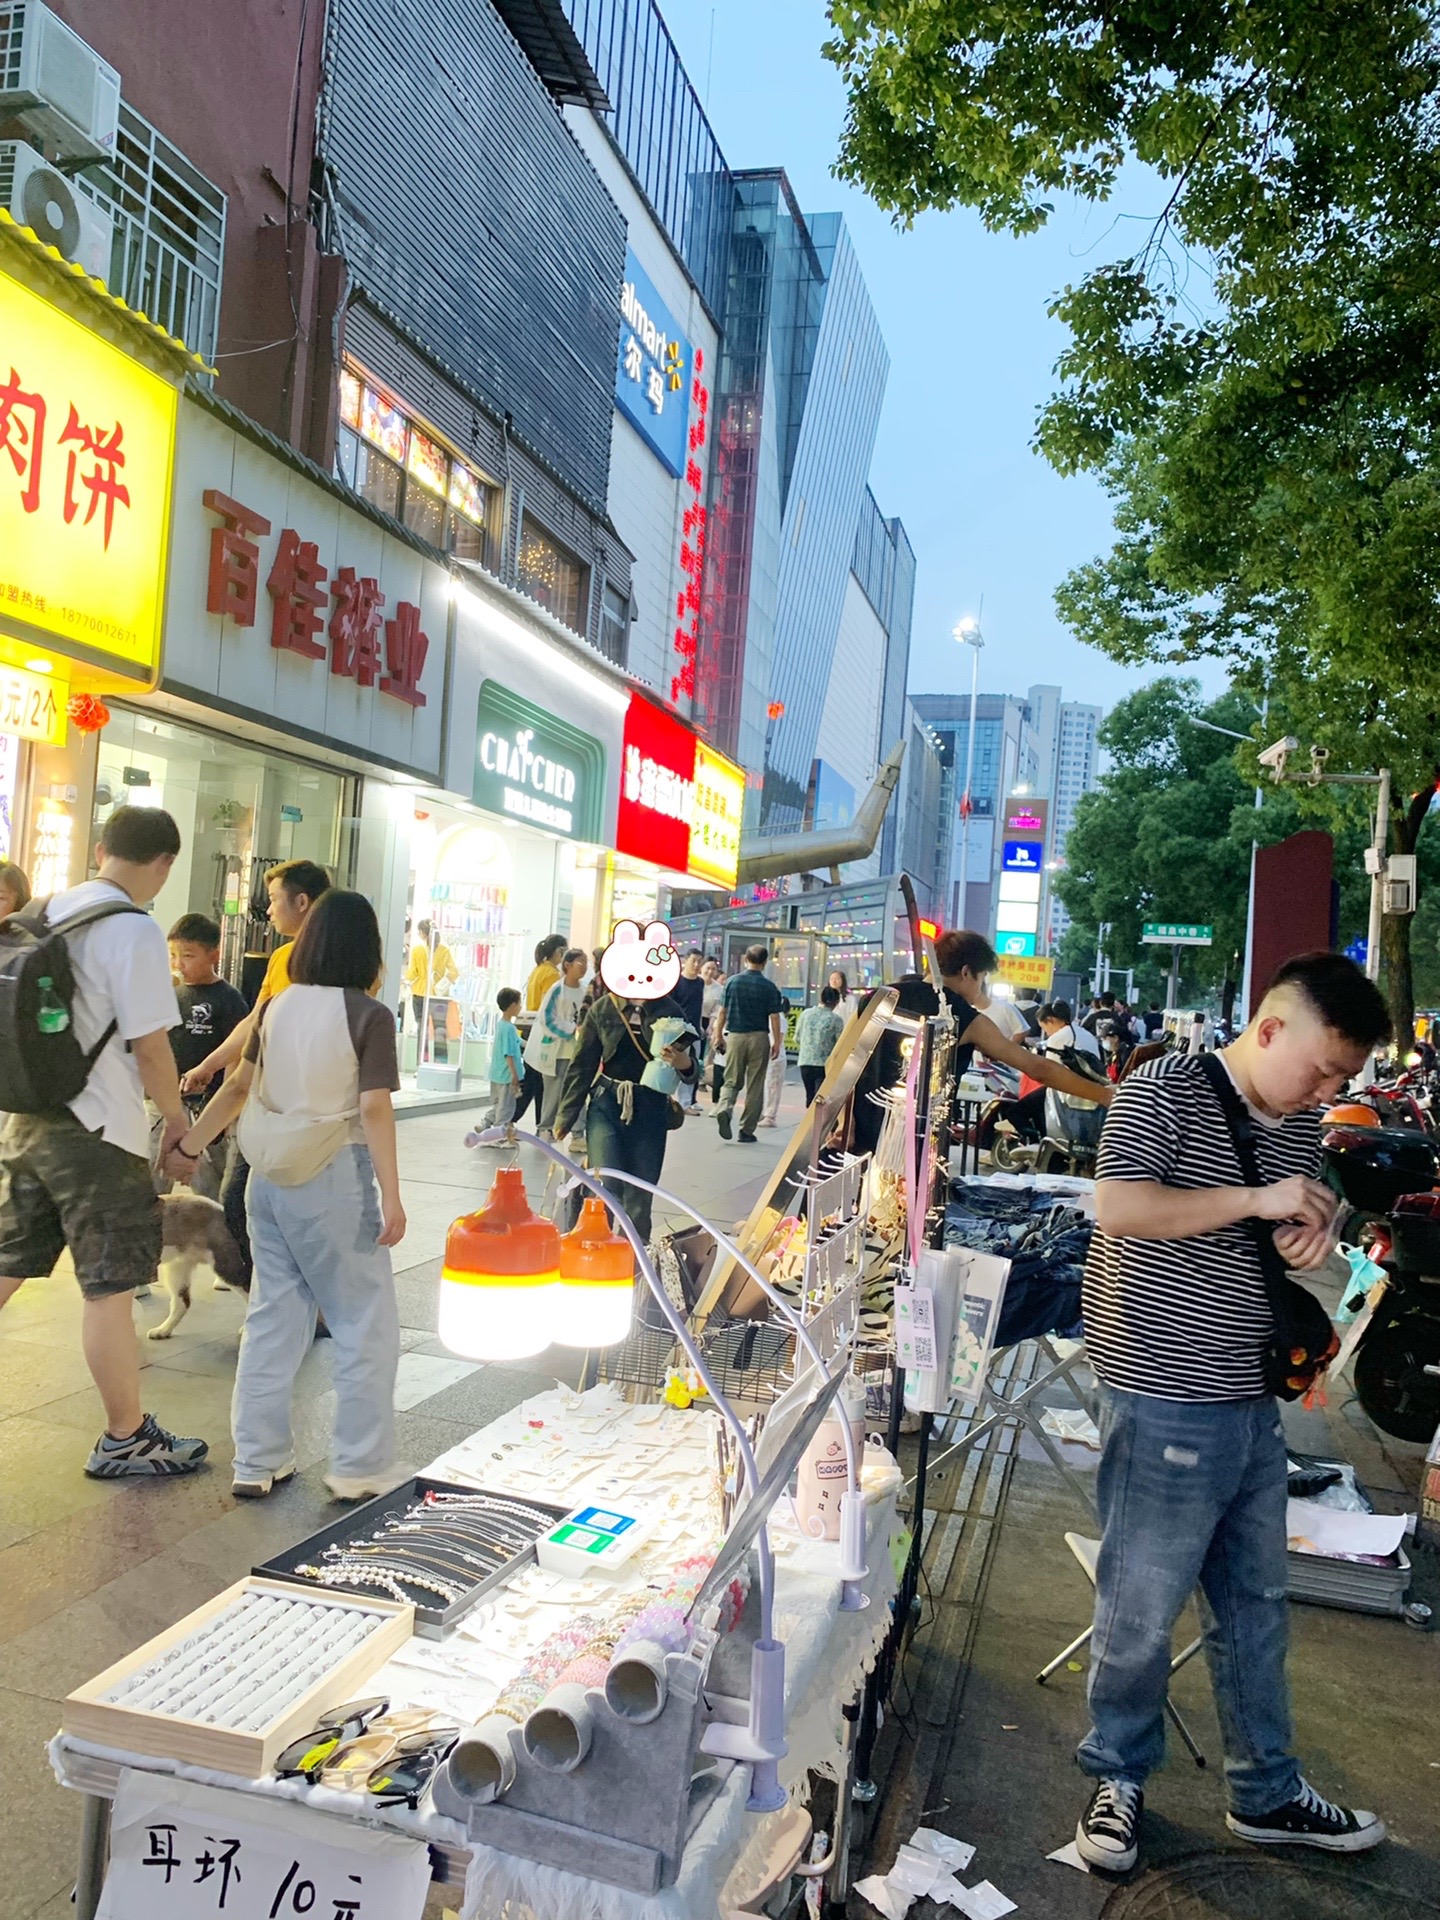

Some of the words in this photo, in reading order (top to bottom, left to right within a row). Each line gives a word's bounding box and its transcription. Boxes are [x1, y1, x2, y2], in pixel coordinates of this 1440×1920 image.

[624, 334, 665, 415] 尔玛
[0, 366, 130, 553] 肉饼
[61, 607, 138, 646] 18770012671
[0, 680, 58, 736] 元/2个
[141, 1823, 242, 1909] 耳环
